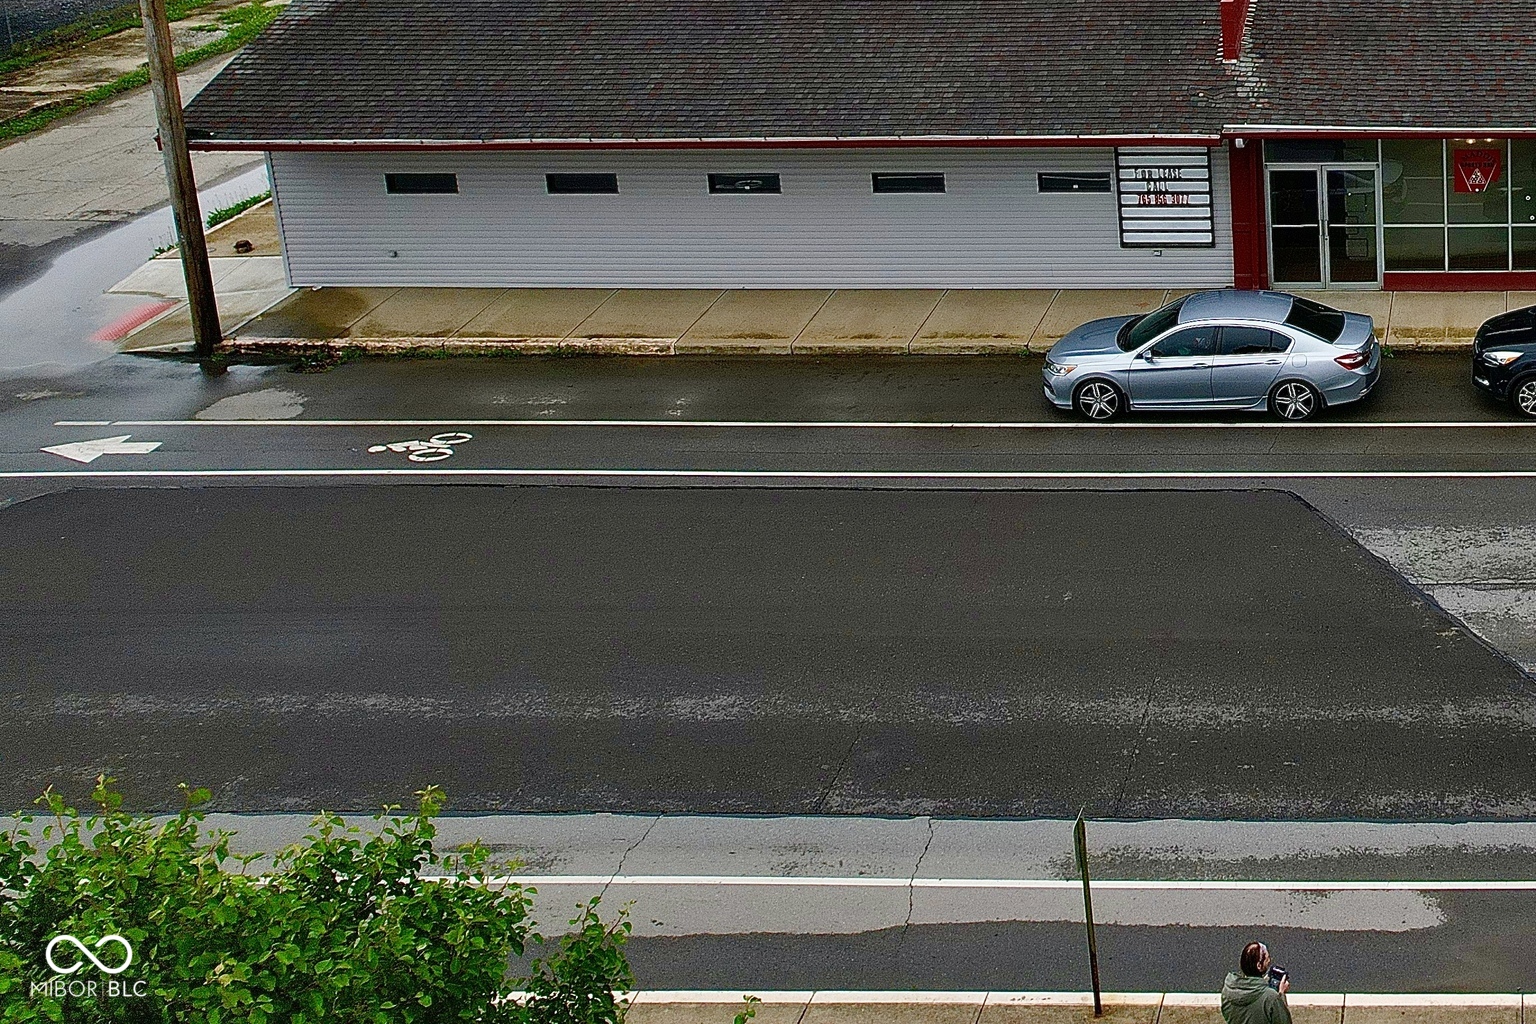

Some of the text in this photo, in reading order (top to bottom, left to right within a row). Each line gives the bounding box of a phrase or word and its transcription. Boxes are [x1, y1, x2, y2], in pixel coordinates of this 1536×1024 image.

[1134, 169, 1182, 179] FOR LEASE
[1146, 181, 1169, 192] CALL
